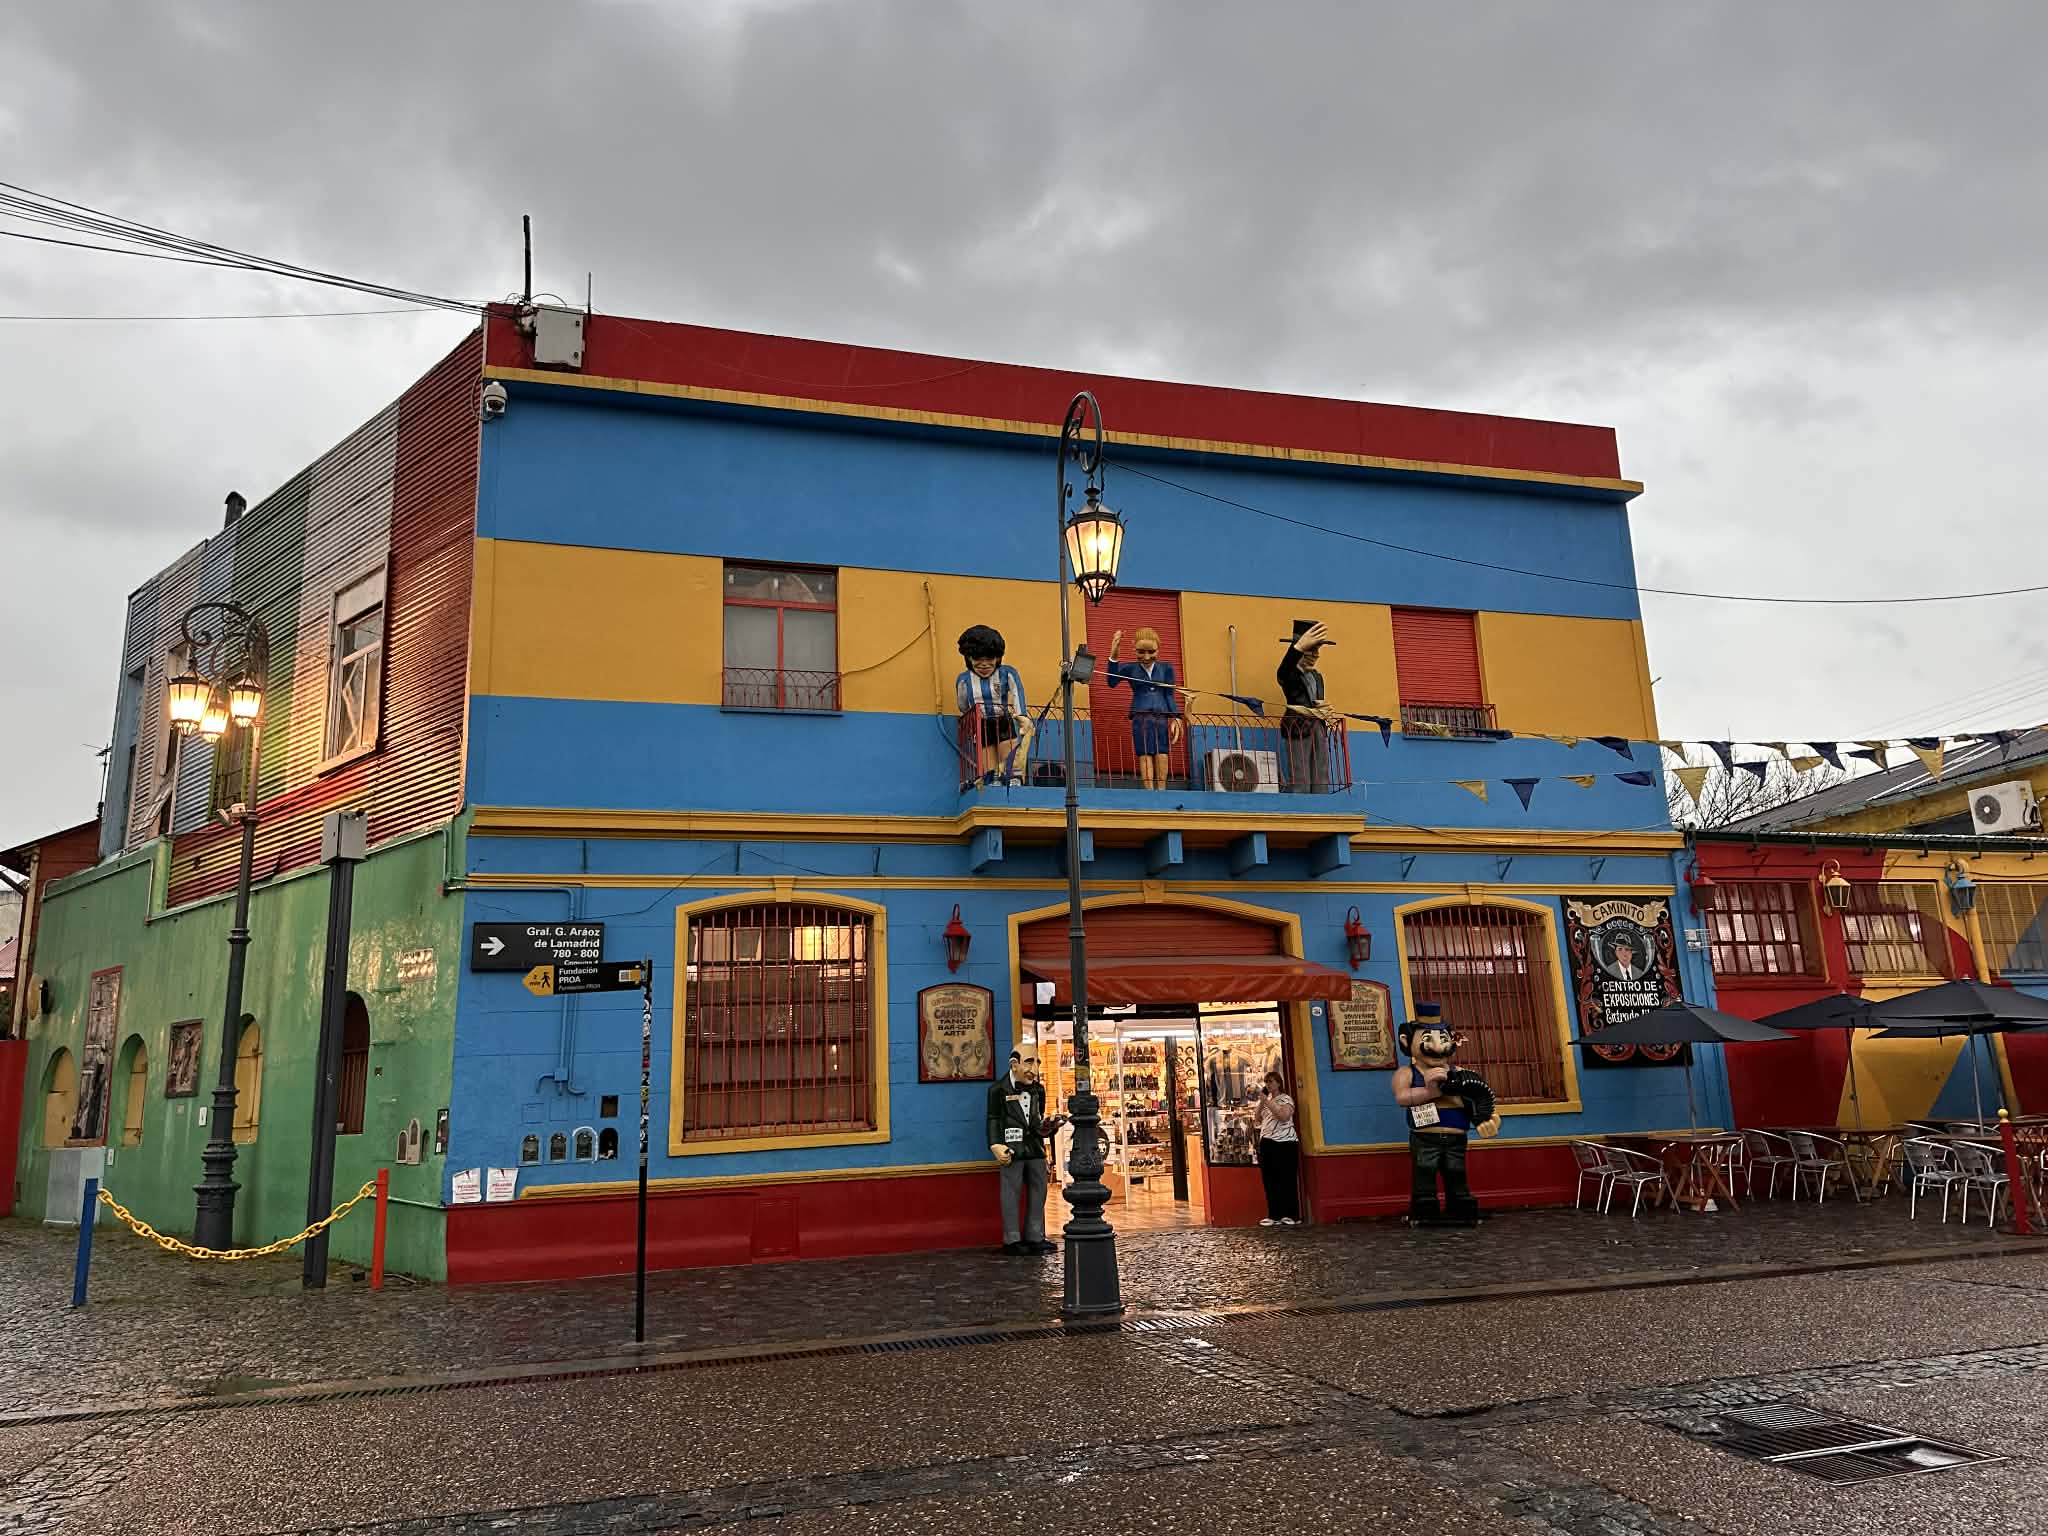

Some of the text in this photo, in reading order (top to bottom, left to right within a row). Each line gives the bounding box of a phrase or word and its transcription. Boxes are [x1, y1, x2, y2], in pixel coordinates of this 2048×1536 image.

[1592, 903, 1645, 922] CAMINITO
[526, 927, 601, 937] Gral. G. Aráoz
[534, 938, 600, 948] de Lamadrid
[552, 949, 571, 958] 780
[580, 949, 599, 958] 800
[559, 967, 598, 975] Fundación
[559, 976, 582, 984] PROA
[1601, 981, 1658, 992] CENTRO DE
[1603, 993, 1660, 1007] EXPOSICIONES
[934, 1009, 978, 1019] CAMINITO
